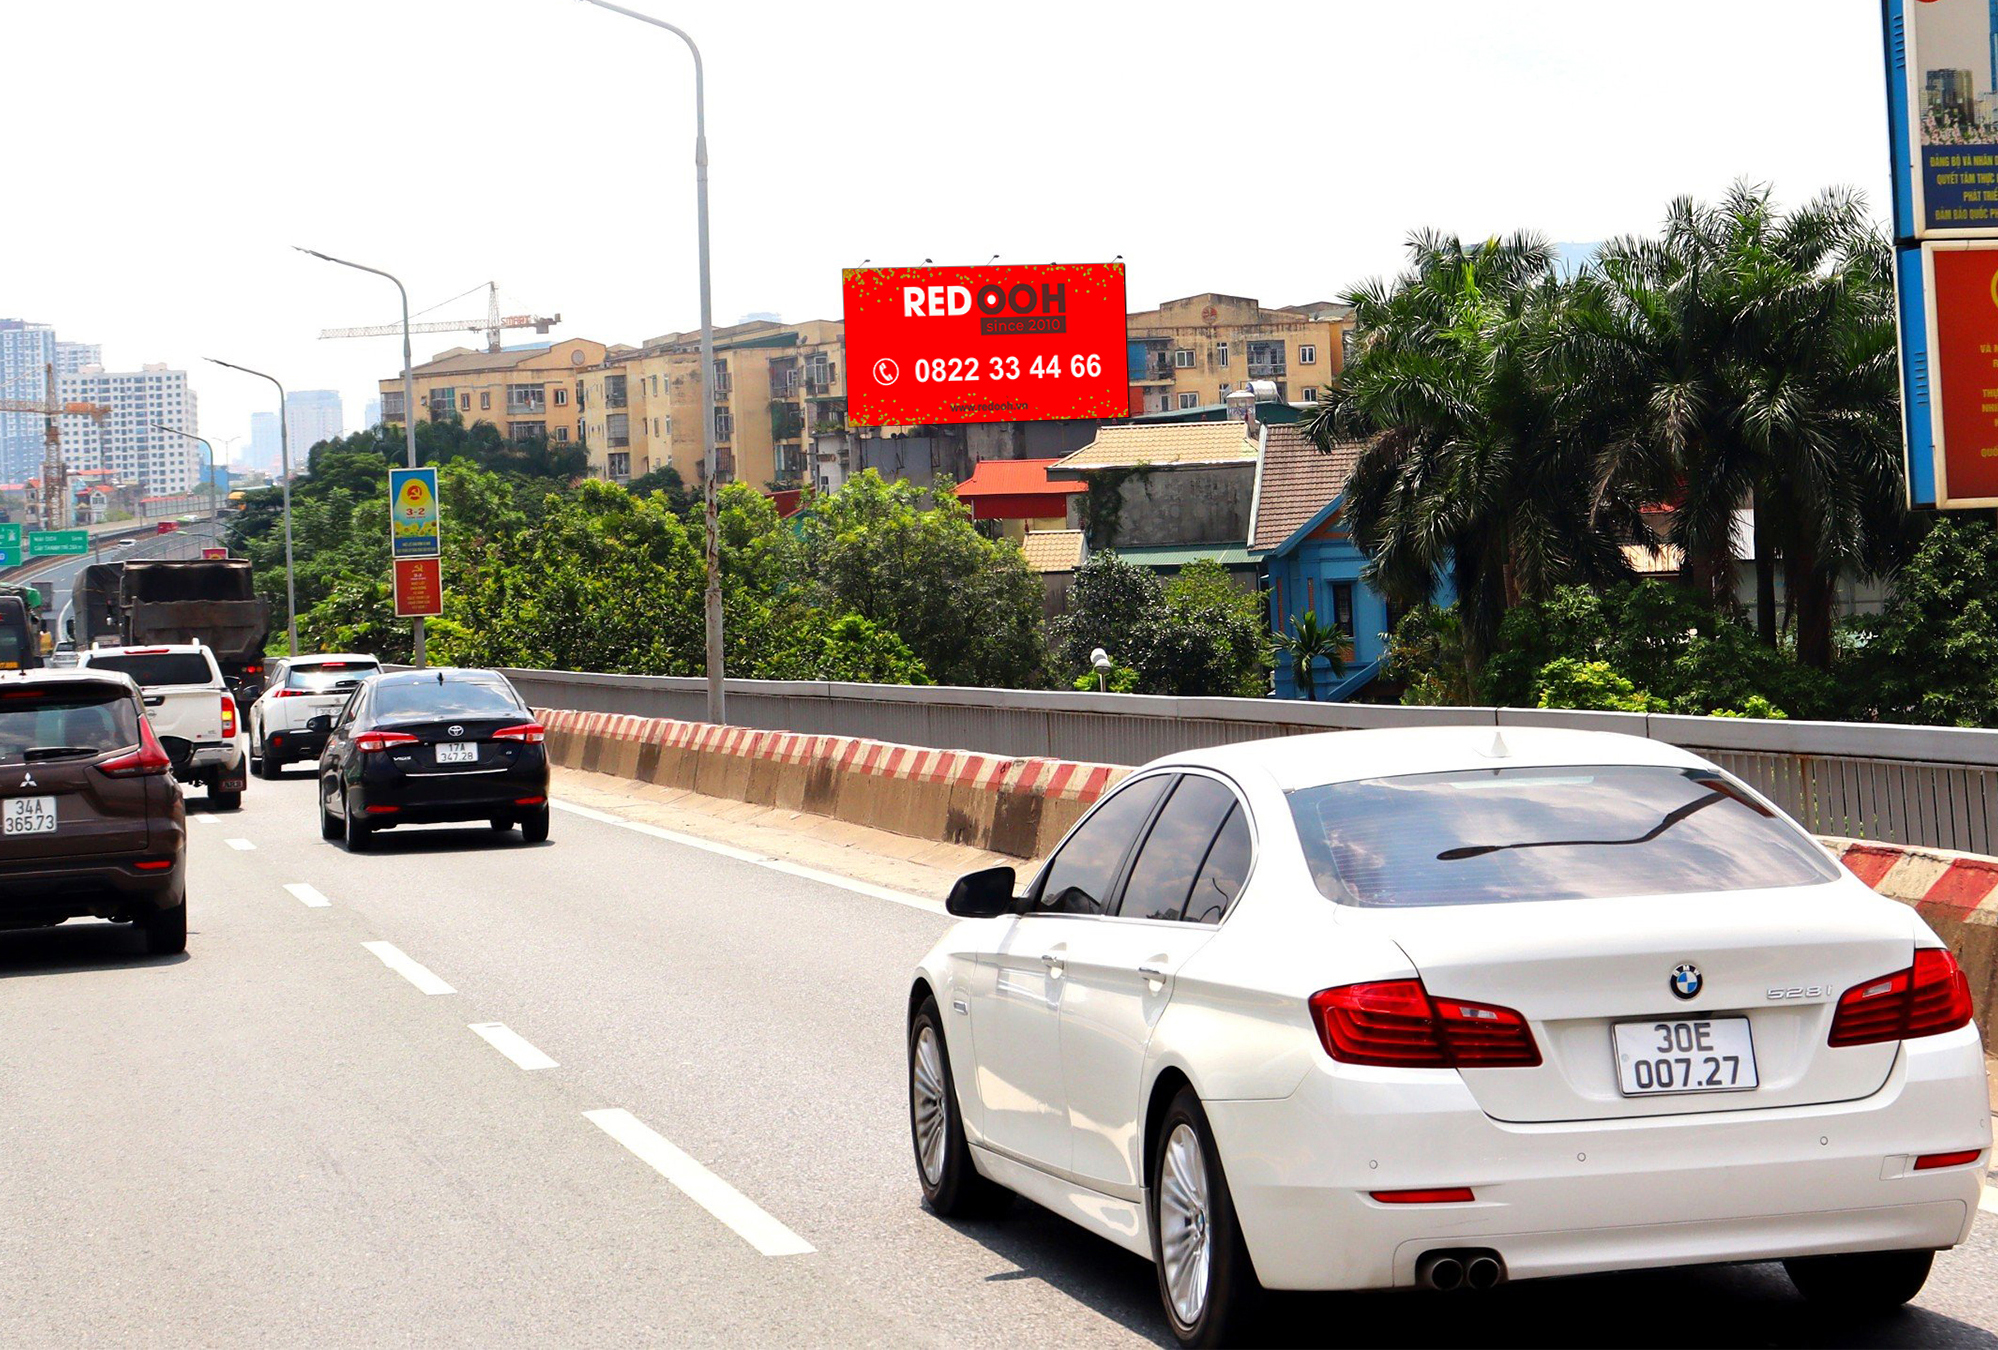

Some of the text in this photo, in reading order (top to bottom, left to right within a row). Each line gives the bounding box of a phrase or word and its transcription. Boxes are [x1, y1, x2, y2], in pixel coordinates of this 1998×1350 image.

[903, 283, 1067, 317] RED OOH
[986, 318, 1061, 333] since 2010
[915, 353, 1102, 383] 0822 33 44 66
[950, 401, 1029, 412] www.redooh.vn
[449, 742, 466, 752] 17A
[440, 751, 474, 762] 347.28
[15, 798, 43, 816] 34A
[5, 814, 55, 833] 365.73
[1654, 1022, 1714, 1054] 30E
[1634, 1055, 1740, 1089] 007.27
